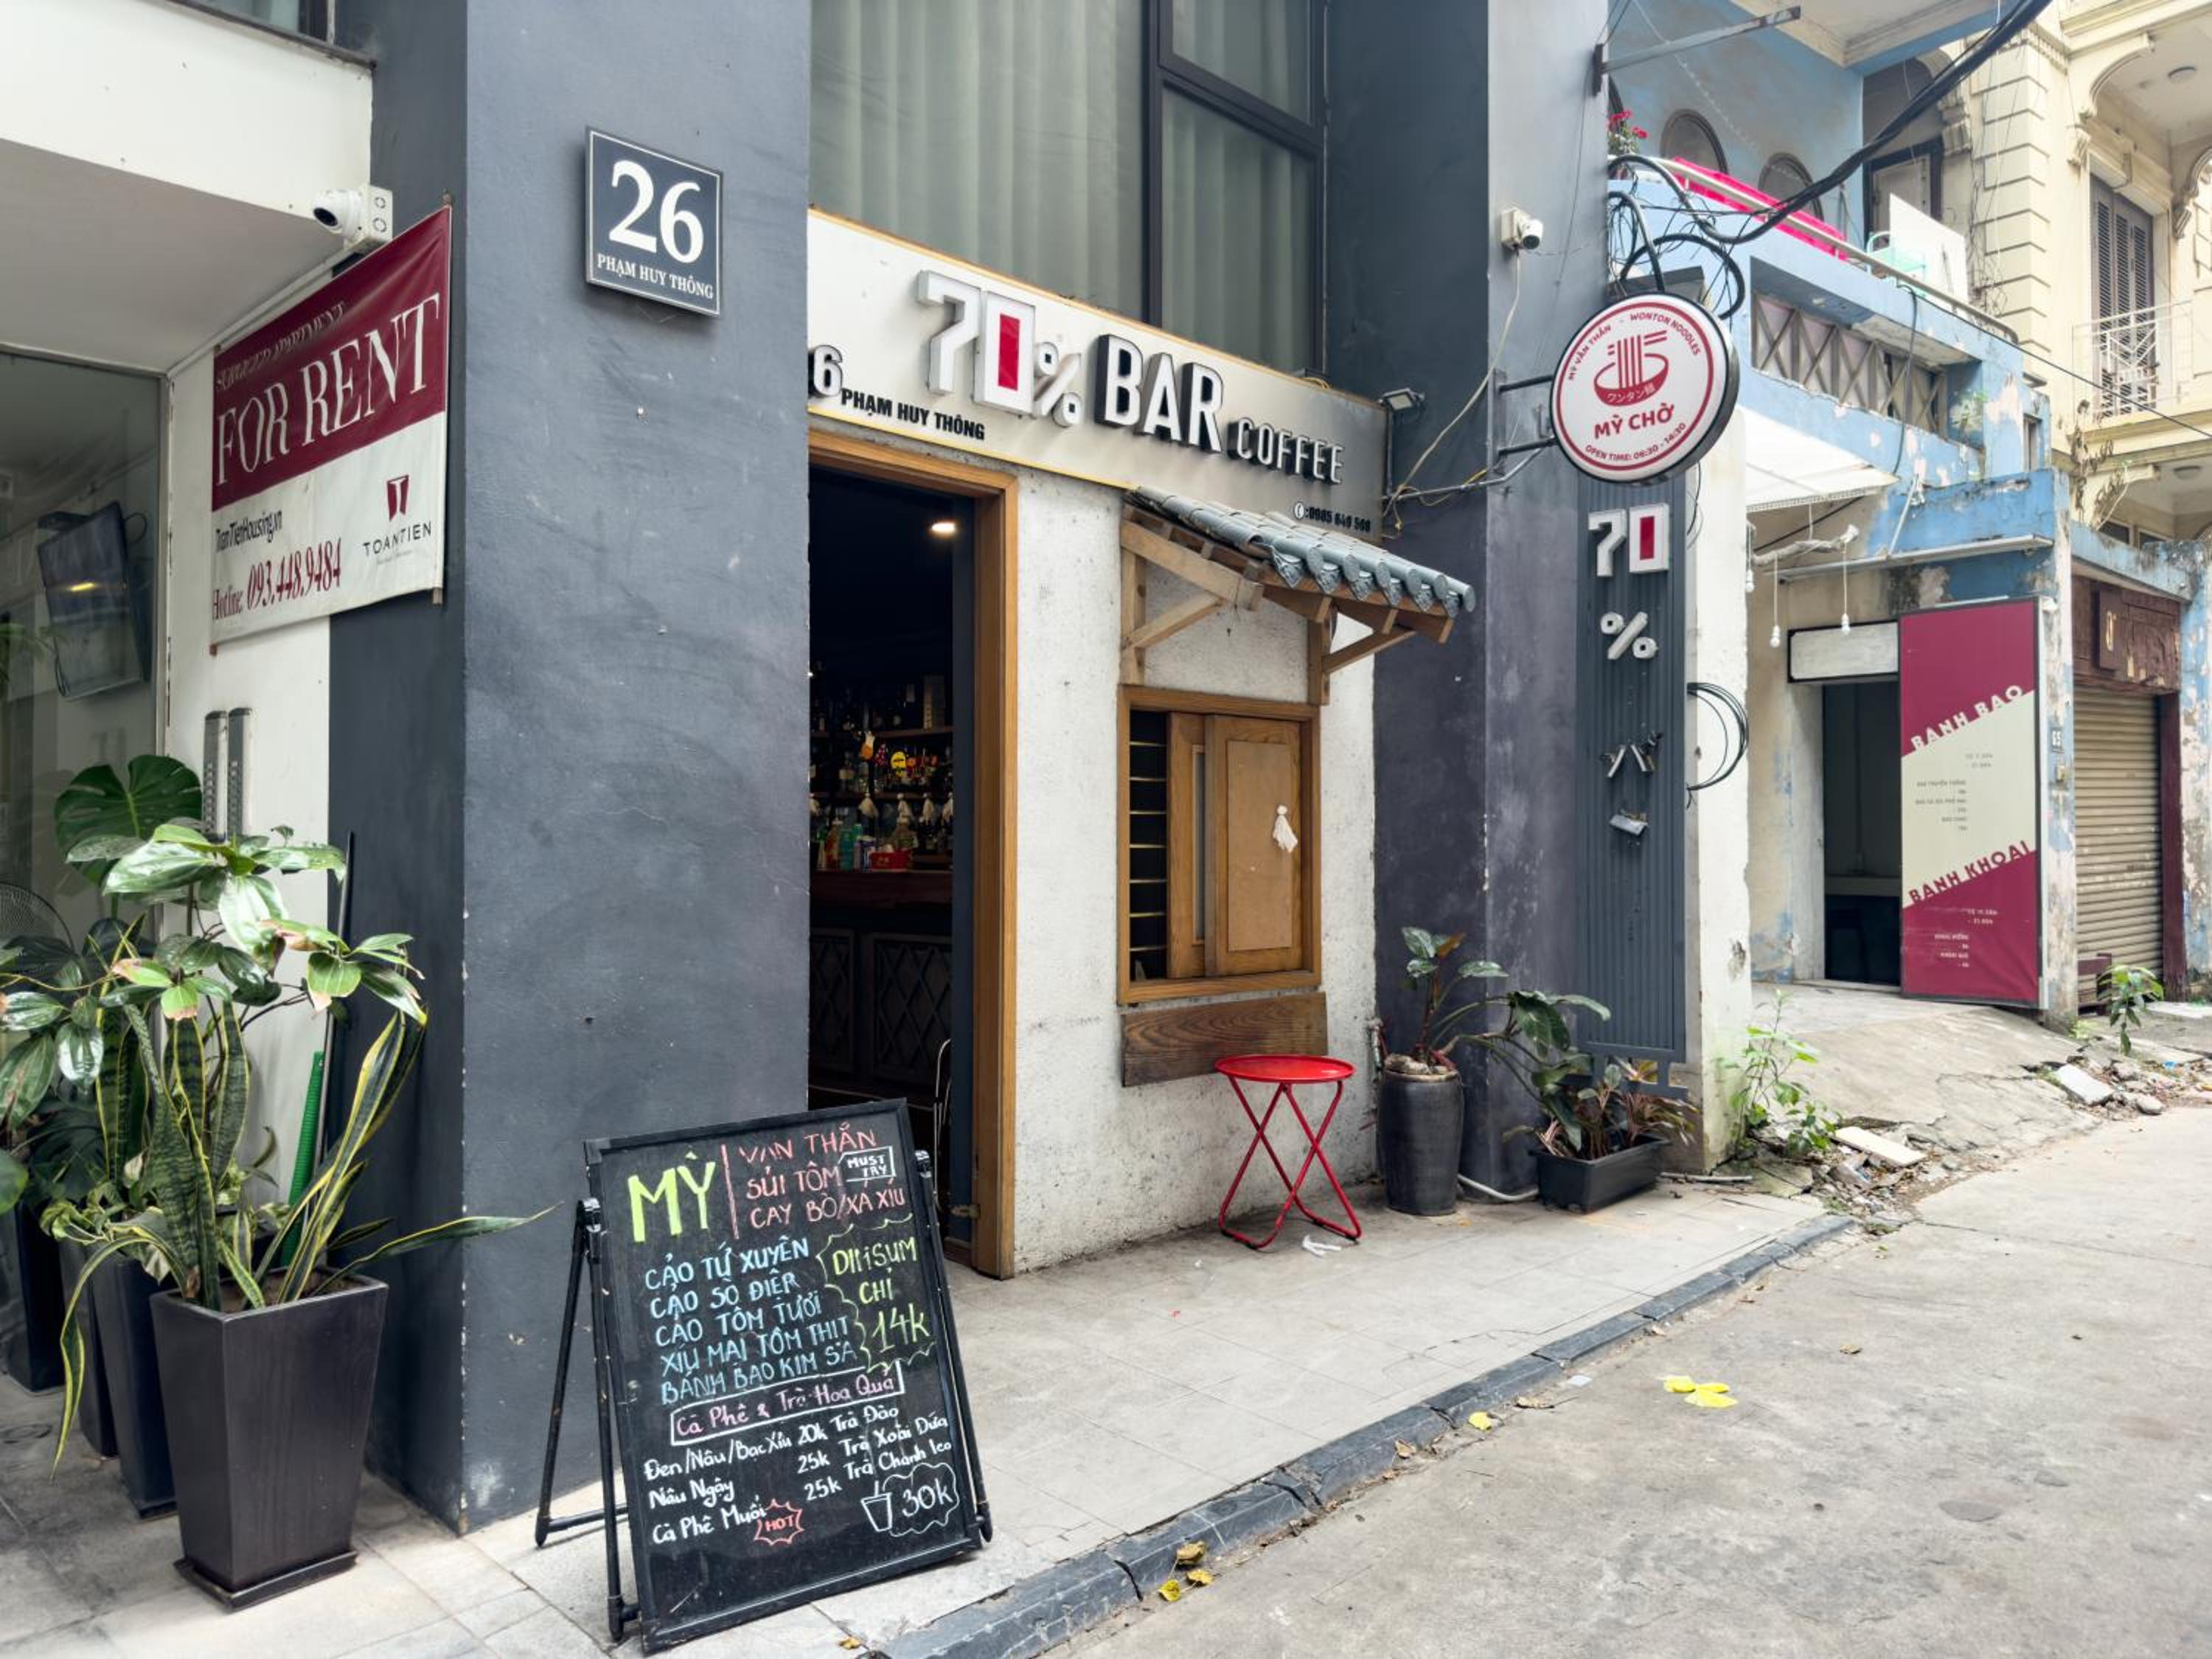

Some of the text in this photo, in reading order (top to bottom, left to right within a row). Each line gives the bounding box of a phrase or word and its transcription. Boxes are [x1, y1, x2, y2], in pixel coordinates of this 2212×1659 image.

[609, 160, 704, 263] 26
[597, 253, 714, 299] PHẠM HUY THÔNG
[1630, 312, 1671, 325] WONTON
[1671, 320, 1701, 355] NOODLES
[217, 293, 440, 487] FOR RENT
[841, 387, 893, 417] PHẠM
[897, 402, 931, 425] HUY
[934, 412, 986, 441] THÔNG
[1095, 333, 1222, 455] BAR
[1230, 417, 1346, 486] COFFEE
[1585, 444, 1606, 459] OPEN
[362, 519, 433, 558] TOANTIEN
[1587, 504, 1669, 577] 70
[246, 535, 343, 612] 093.448.9484
[1600, 611, 1658, 660] %
[1964, 840, 2031, 878] KHOAI
[794, 1161, 844, 1192] TÔM
[846, 1155, 886, 1169] MUST
[862, 1165, 888, 1178] TRY
[751, 1203, 792, 1229] CAY
[740, 1235, 810, 1273] XUYÊN
[716, 1306, 765, 1335] TÔM
[757, 1327, 802, 1357] TÔM
[734, 1362, 774, 1389] BAO
[779, 1352, 818, 1377] KIM
[709, 1403, 749, 1428] Phê
[810, 1383, 852, 1405] Hoa
[830, 1411, 859, 1433] Trà
[798, 1422, 830, 1446] 20k
[838, 1435, 870, 1457] Trà
[649, 1486, 686, 1510] Nâu
[797, 1450, 832, 1474] 25k
[843, 1459, 874, 1480] Trà
[878, 1444, 927, 1471] Chanh
[679, 1514, 715, 1539] Phê
[765, 1514, 796, 1533] HOT
[804, 1476, 843, 1501] 25k
[902, 1478, 954, 1517] 30k
